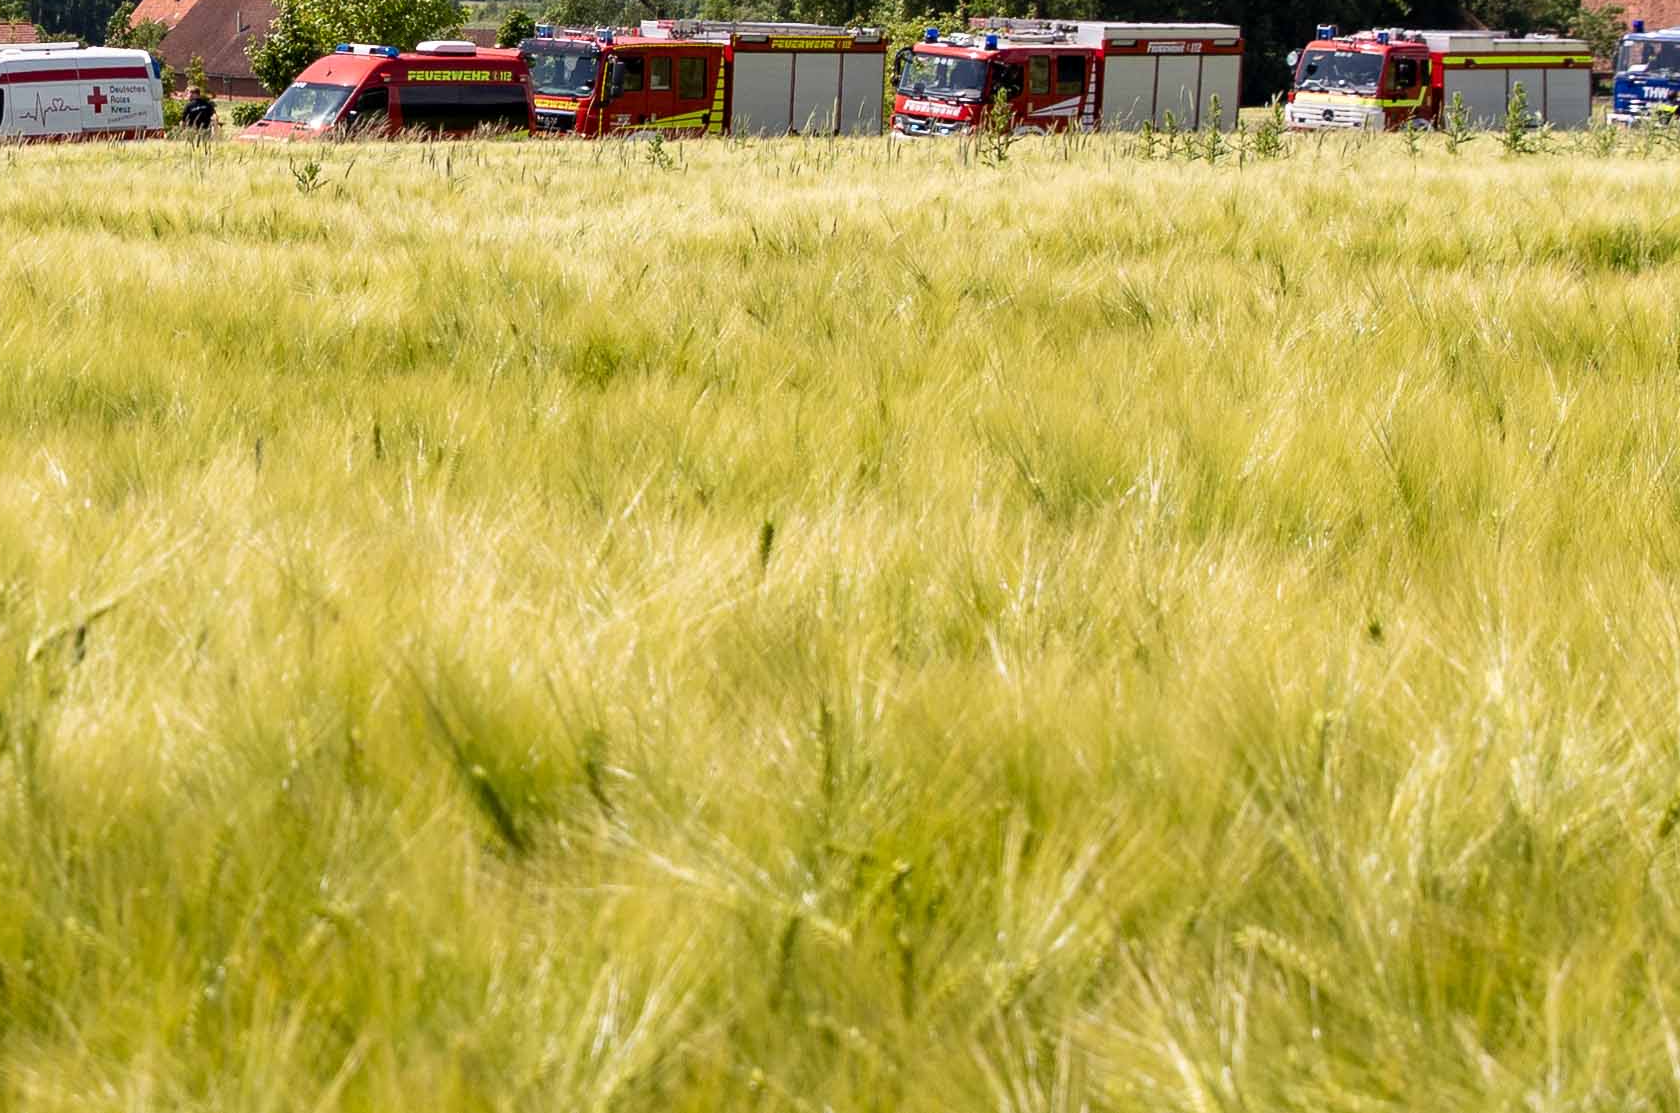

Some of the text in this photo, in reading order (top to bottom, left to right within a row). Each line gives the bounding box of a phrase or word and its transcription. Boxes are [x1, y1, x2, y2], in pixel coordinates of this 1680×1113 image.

[771, 39, 835, 49] FEUERWEHR
[407, 70, 489, 81] FEUERWEHR
[1642, 87, 1670, 99] THW
[903, 99, 962, 117] FEUERWEHR
